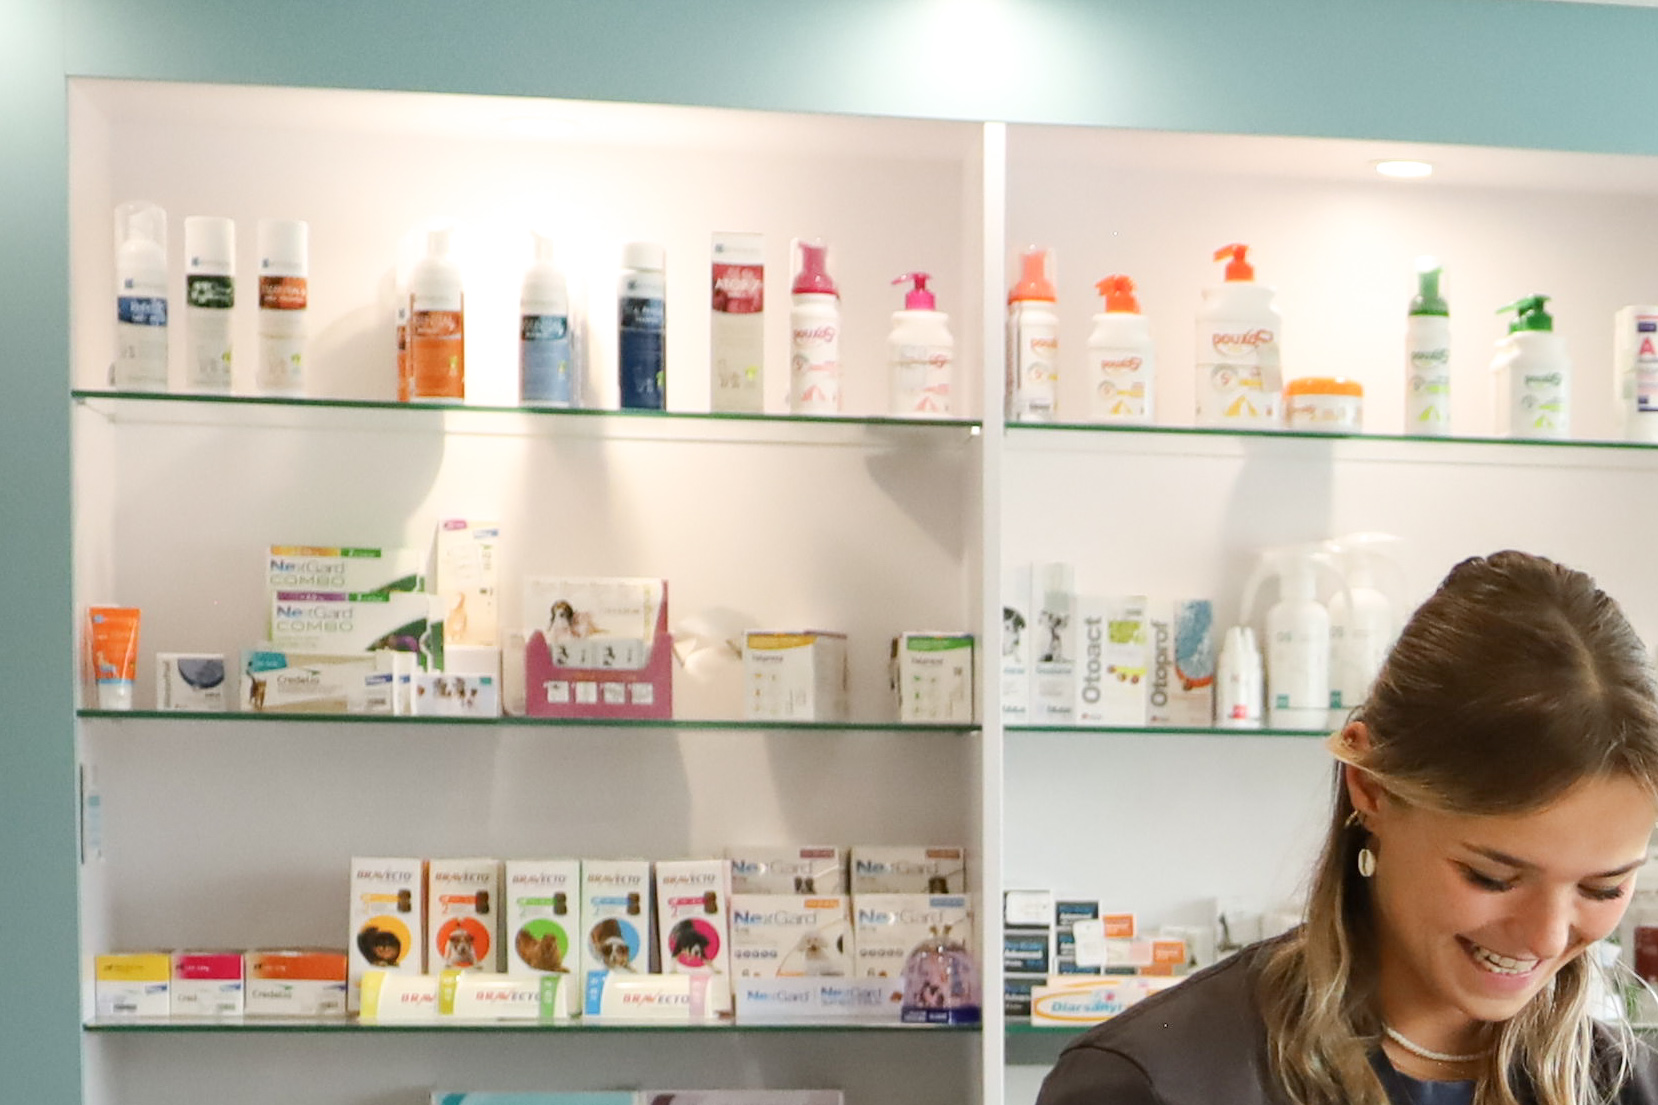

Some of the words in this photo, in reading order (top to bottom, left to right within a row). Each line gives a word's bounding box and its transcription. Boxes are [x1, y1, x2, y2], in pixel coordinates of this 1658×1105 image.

[1639, 336, 1656, 356] A
[1082, 616, 1101, 704] Otoact
[357, 870, 412, 881] BRAVECTO
[435, 871, 490, 881] BRAVECTO
[512, 874, 566, 885] BRAVECTO
[588, 874, 641, 885] BRAVECTO
[663, 873, 715, 885] BRAVECTO
[734, 910, 817, 926] NexGard
[859, 909, 943, 926] NexGard
[401, 992, 435, 1003] BRAV
[623, 991, 690, 1005] BRAVECTO
[747, 989, 809, 1001] NexGard
[820, 986, 881, 999] NexGard
